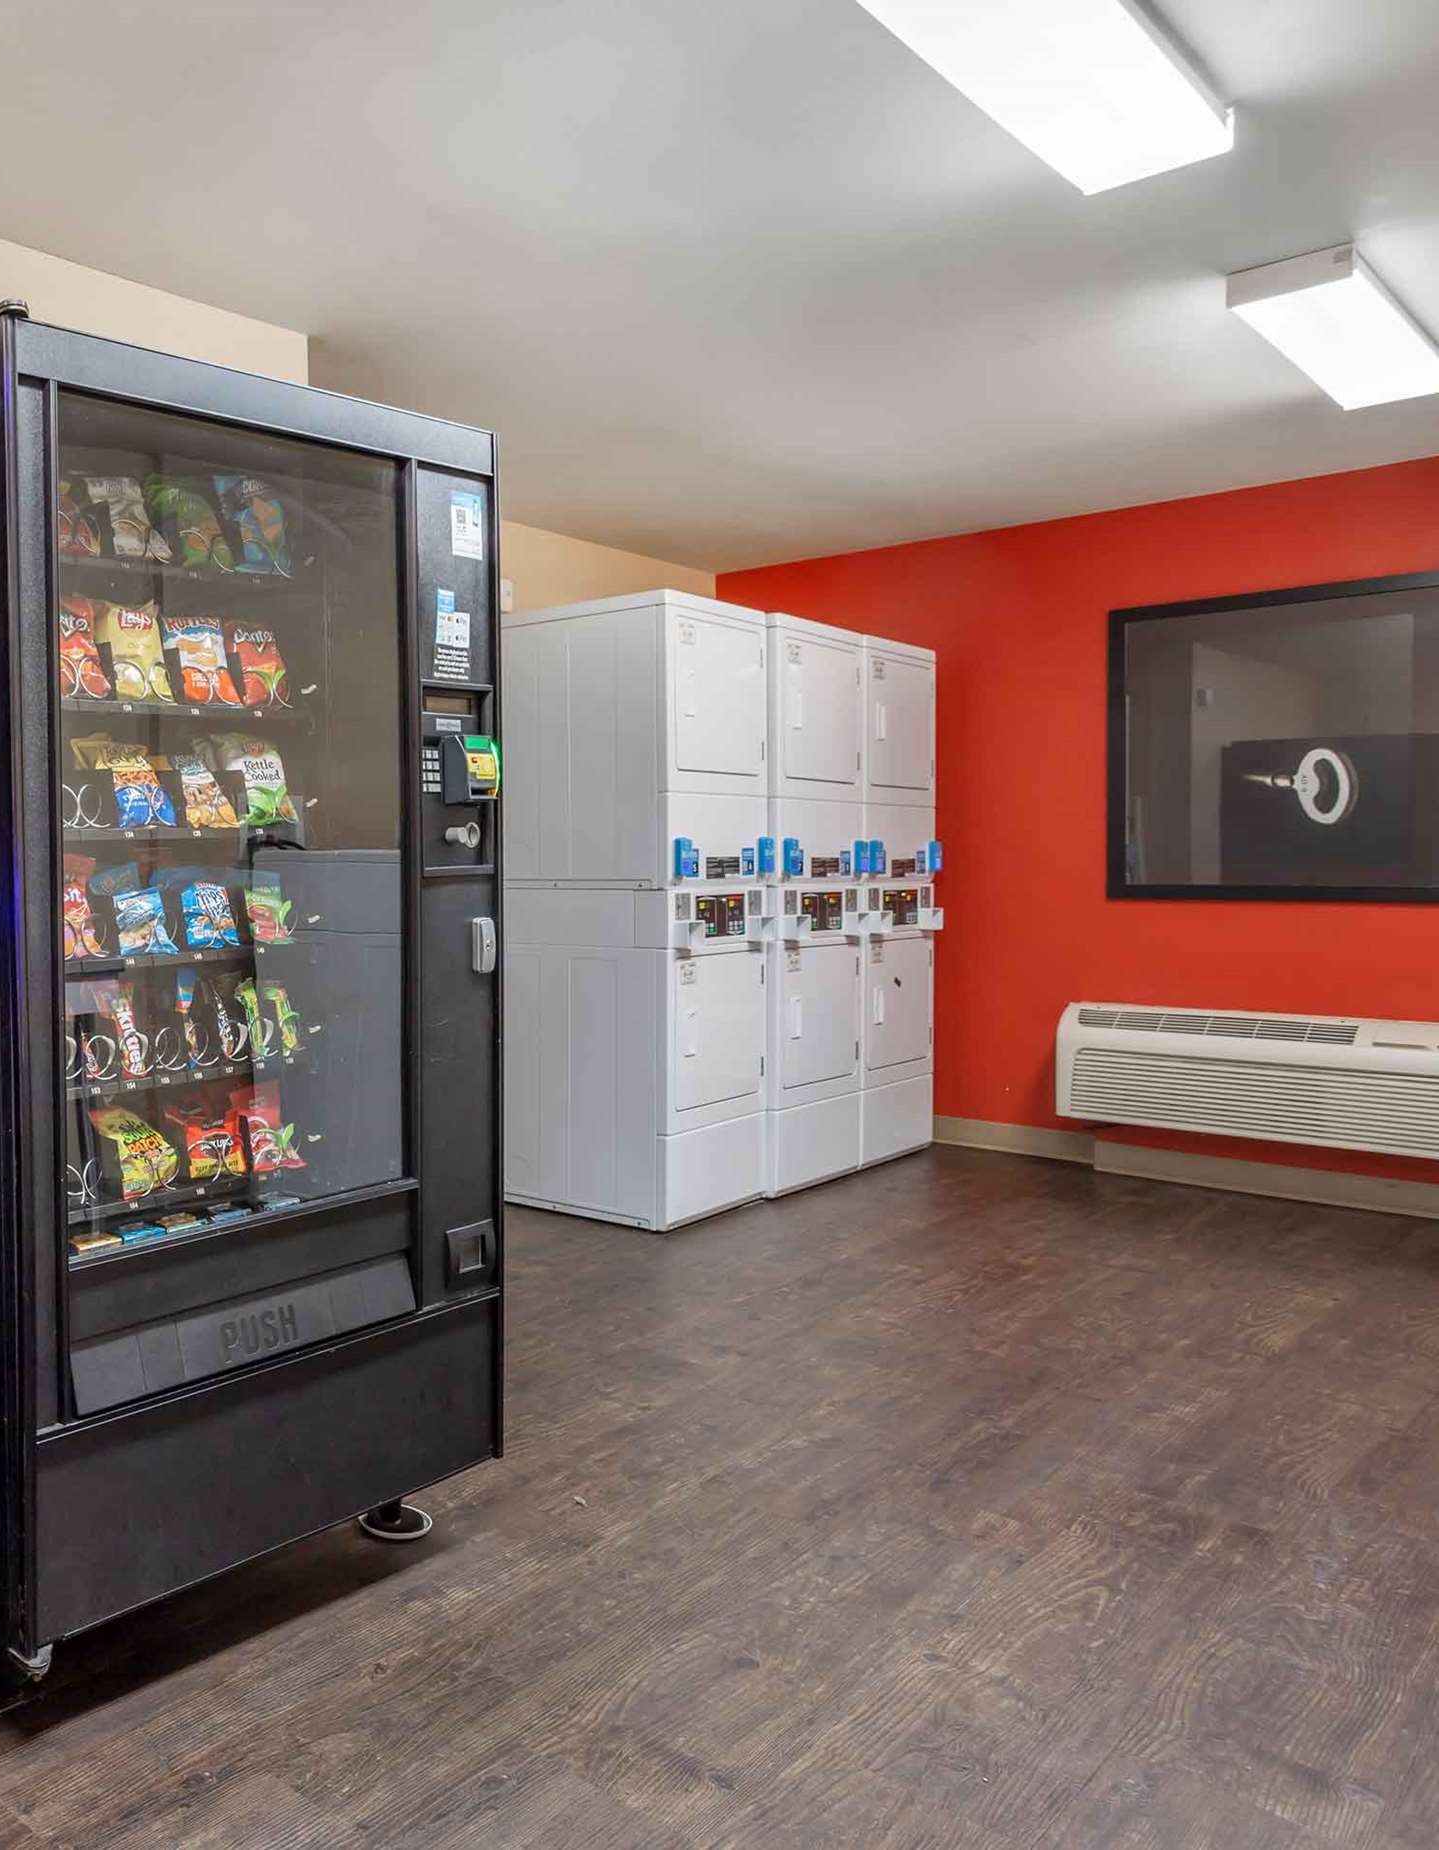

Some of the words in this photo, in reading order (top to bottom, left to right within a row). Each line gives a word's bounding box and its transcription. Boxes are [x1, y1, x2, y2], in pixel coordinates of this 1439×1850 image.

[243, 759, 274, 771] Kettle
[127, 1136, 162, 1153] PATCH
[221, 1304, 301, 1359] PUSH
